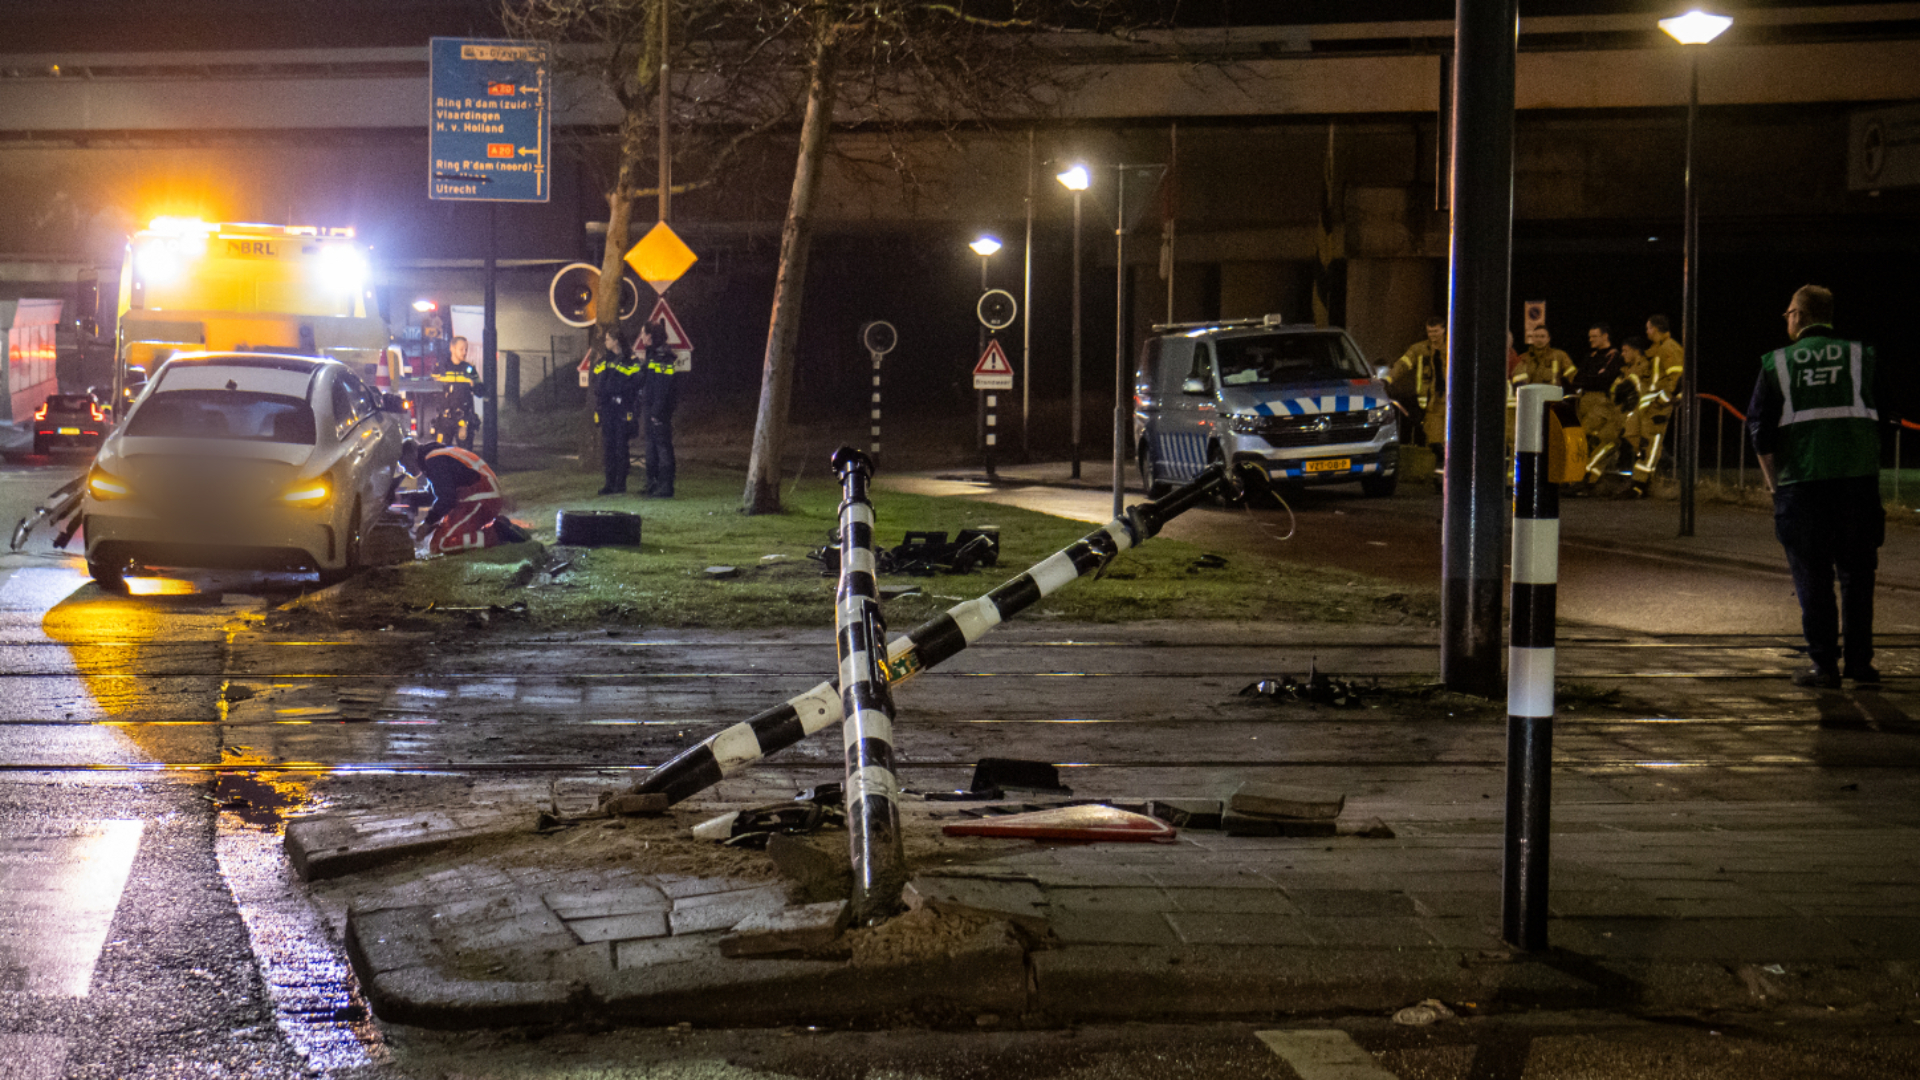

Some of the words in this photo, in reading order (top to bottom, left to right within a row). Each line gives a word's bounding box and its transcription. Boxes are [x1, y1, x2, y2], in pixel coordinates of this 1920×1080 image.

[436, 97, 461, 110] Ring
[464, 98, 498, 109] R'dam
[436, 109, 501, 123] Vlaardingen
[436, 121, 448, 133] H.
[450, 123, 461, 133] v.
[463, 122, 505, 134] Holland
[491, 146, 512, 156] A20
[435, 159, 460, 173] Ring
[463, 160, 494, 171] R'dam
[496, 161, 533, 172] (noord)
[435, 183, 477, 195] Utrecht
[1797, 365, 1843, 388] RET
